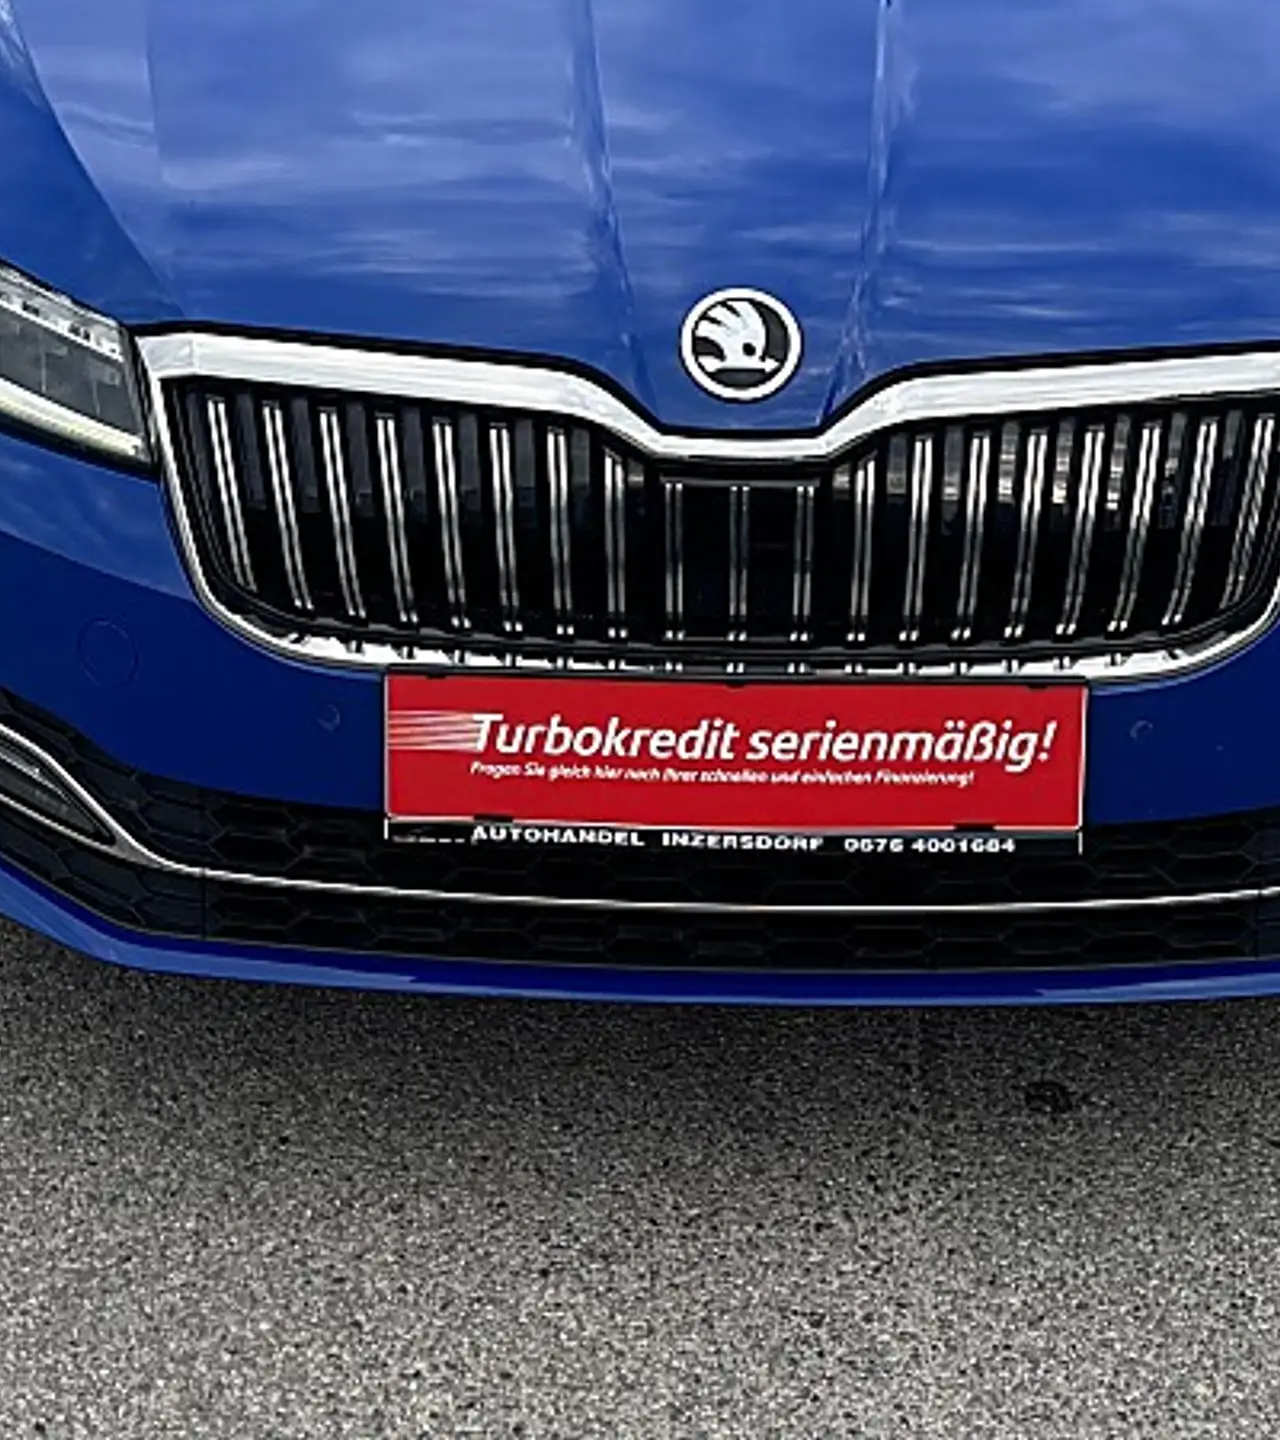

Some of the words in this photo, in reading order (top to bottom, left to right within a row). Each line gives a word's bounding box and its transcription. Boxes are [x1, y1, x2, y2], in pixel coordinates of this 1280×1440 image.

[472, 713, 741, 761] Turbokredit
[746, 720, 1058, 773] serienmäßig!
[471, 762, 521, 779] Fragen
[523, 762, 545, 777] Sie
[549, 764, 590, 781] gleich
[594, 765, 622, 779] hier
[624, 766, 660, 781] nach
[700, 768, 768, 783] schnellen
[770, 769, 798, 784] und
[800, 770, 872, 785] einfachen
[875, 770, 975, 788] Finanzierung!
[472, 825, 645, 846] AUTOHANDEL
[662, 832, 824, 850] INZERSDORF
